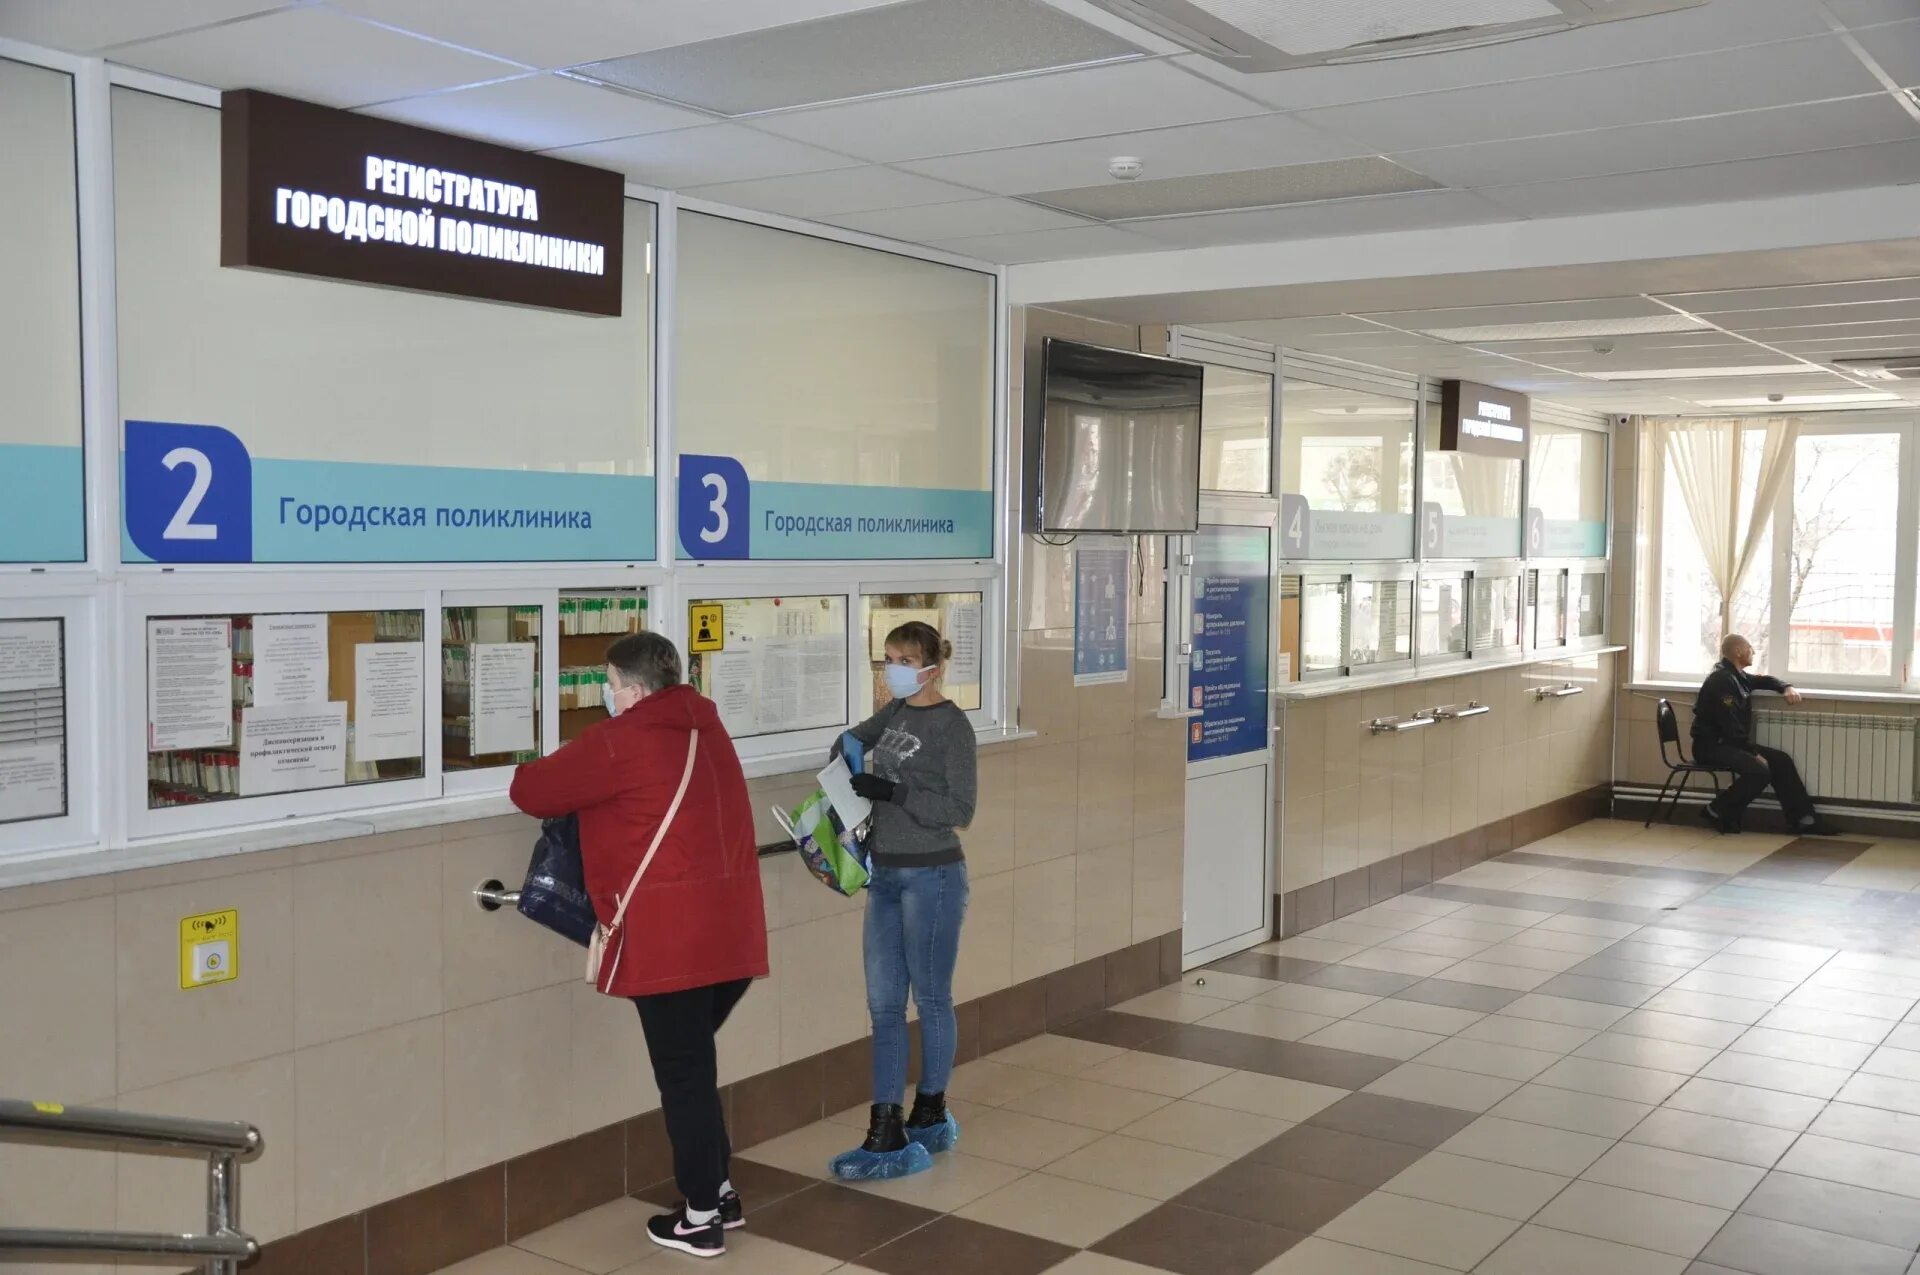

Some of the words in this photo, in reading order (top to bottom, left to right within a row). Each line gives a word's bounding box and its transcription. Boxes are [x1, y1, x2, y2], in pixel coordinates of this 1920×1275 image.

[365, 156, 539, 222] РЕГИСТРАТУРА
[275, 187, 436, 249] ГОРОДСКОЙ
[438, 215, 605, 275] ПОЛИКЛИНИКИ
[161, 446, 218, 540] 2
[279, 496, 426, 531] Городская
[436, 506, 592, 530] поликлиника
[699, 472, 729, 544] 3
[765, 510, 853, 536] Городская
[857, 516, 954, 535] поликлиника
[1287, 505, 1303, 549] 4
[1428, 511, 1438, 549] 5
[1531, 516, 1540, 549] 6
[250, 745, 313, 758] профилактический
[314, 744, 337, 752] осмотр
